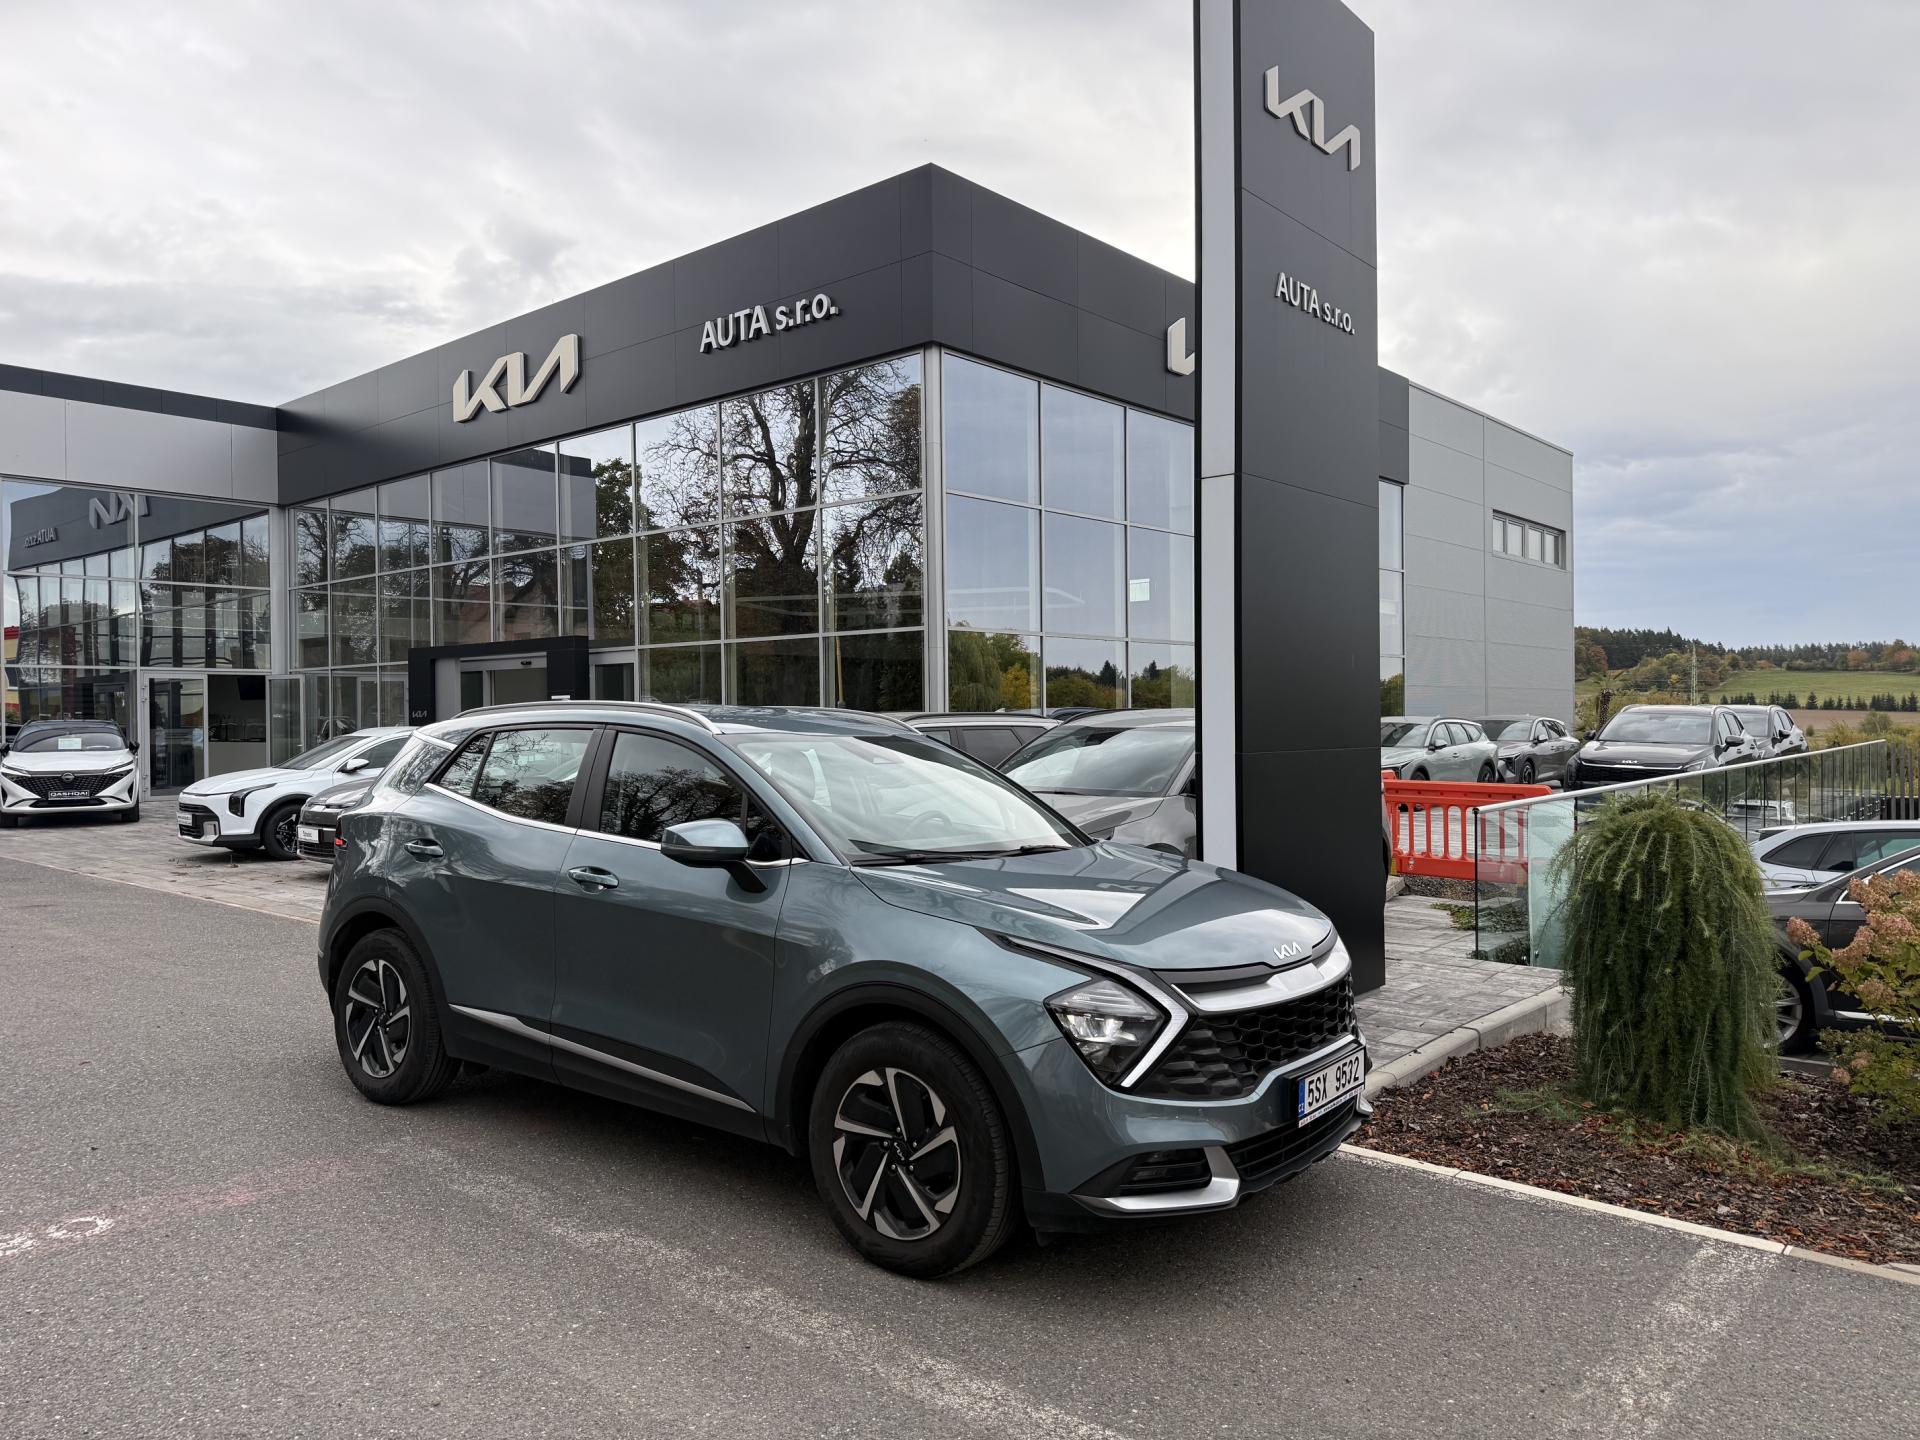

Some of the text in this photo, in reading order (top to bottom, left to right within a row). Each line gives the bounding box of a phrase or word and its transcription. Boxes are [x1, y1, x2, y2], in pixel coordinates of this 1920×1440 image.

[1264, 65, 1361, 171] KIA
[700, 293, 839, 353] AUTA s.r.o.
[1275, 271, 1356, 335] AUTA s.r.o.
[453, 333, 581, 422] KIA
[1273, 941, 1302, 960] KIA
[1307, 1056, 1360, 1108] 5SX 9532
